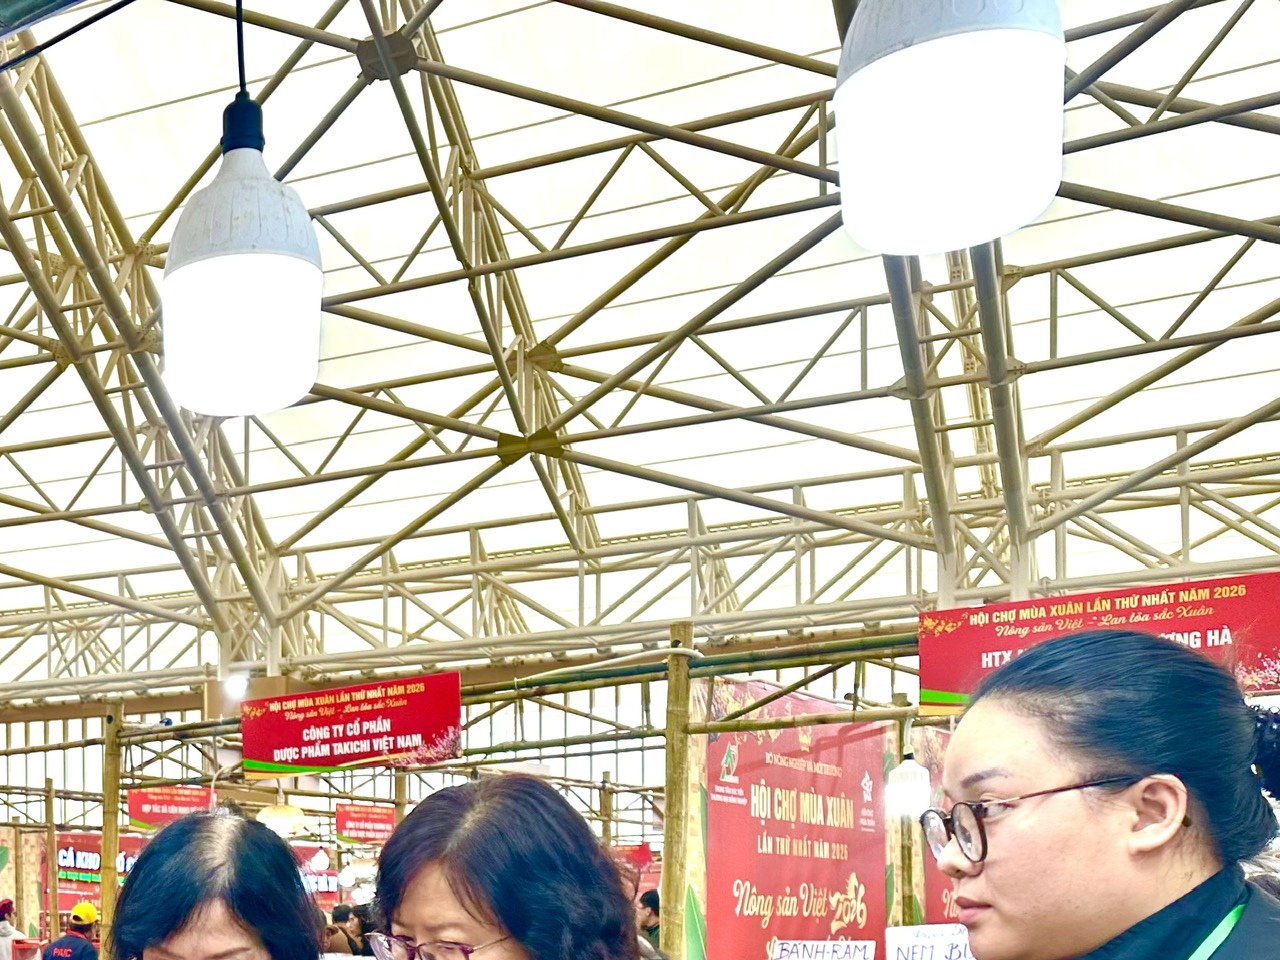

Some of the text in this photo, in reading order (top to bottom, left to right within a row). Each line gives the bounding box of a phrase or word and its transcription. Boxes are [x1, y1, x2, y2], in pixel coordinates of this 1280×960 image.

[969, 584, 1247, 627] HỘI CHỢ MÙA XUÂN LẦN THỨ NHẤT NĂM 2026
[1207, 625, 1233, 647] HÀ
[406, 682, 425, 695] 2026
[302, 716, 391, 742] CÔNG TY CỔ PHẦN
[332, 739, 371, 756] TAKICHI
[372, 736, 395, 753] VIỆT
[397, 733, 422, 748] NAM
[751, 779, 771, 826] HỘI
[774, 788, 798, 829] CHỢ
[800, 787, 825, 828] MÙA
[826, 791, 854, 829] XUÂN
[757, 831, 773, 855] LẦN
[792, 834, 812, 858] NHẤT
[76, 851, 101, 870] KHO
[733, 879, 774, 929] Nông
[775, 886, 798, 917] sản
[800, 882, 828, 923] Việt
